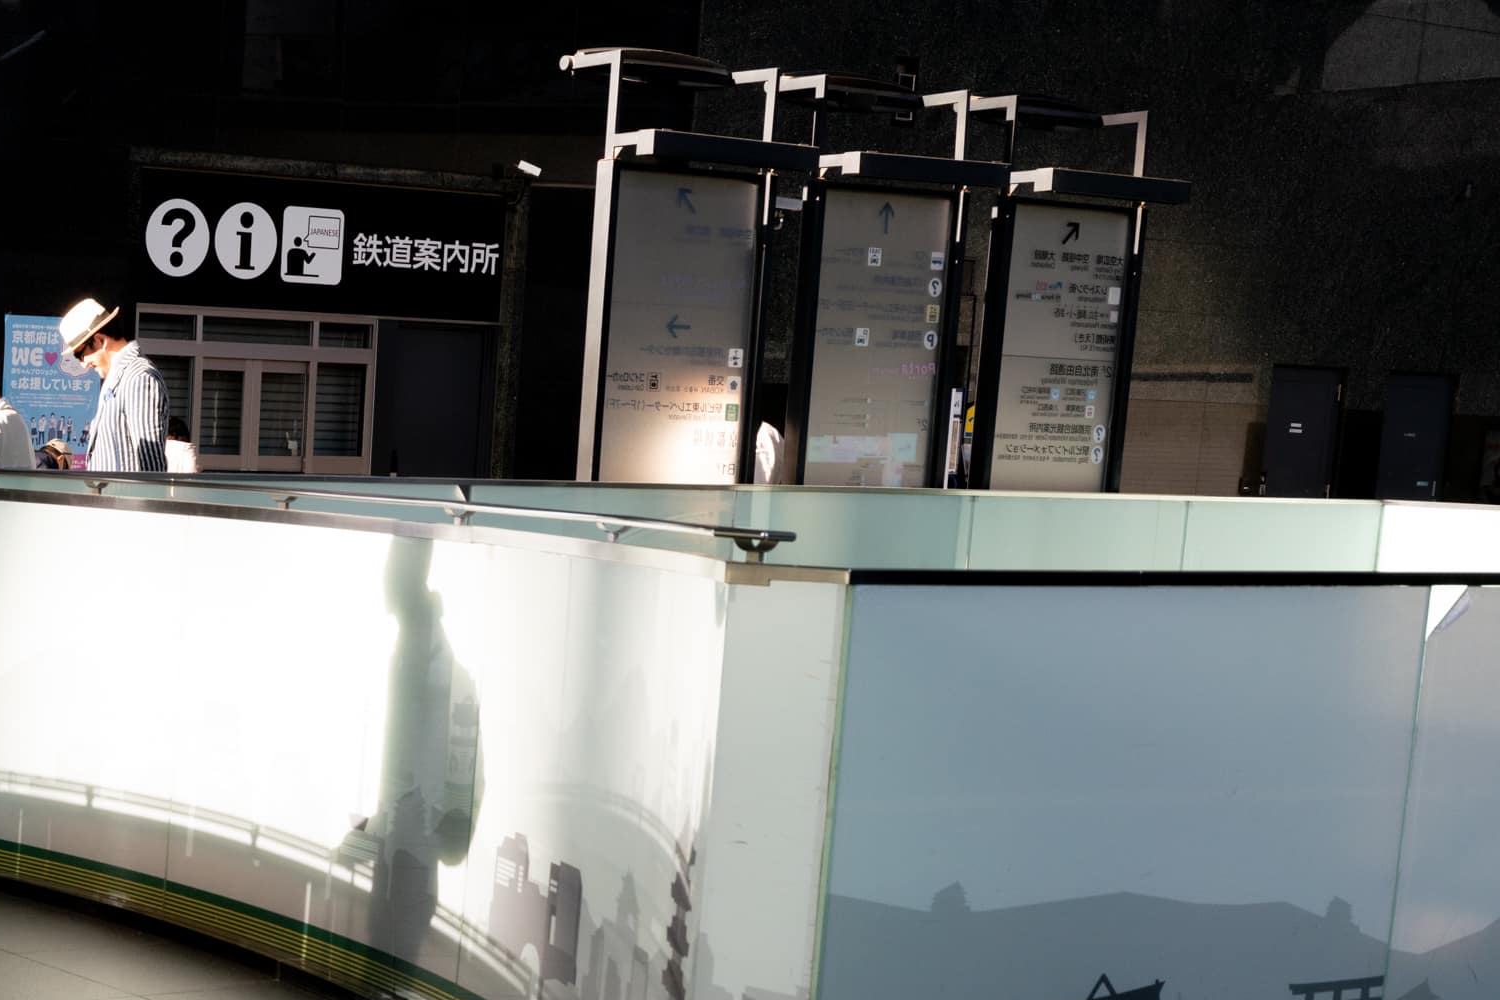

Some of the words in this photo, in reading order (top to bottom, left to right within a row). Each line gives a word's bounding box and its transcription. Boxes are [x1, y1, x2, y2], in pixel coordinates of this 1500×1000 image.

[310, 228, 339, 238] JAPANESE
[352, 232, 500, 276] 鉄道案内所
[11, 330, 59, 344] 京都府は
[10, 377, 94, 392] を応援しています
